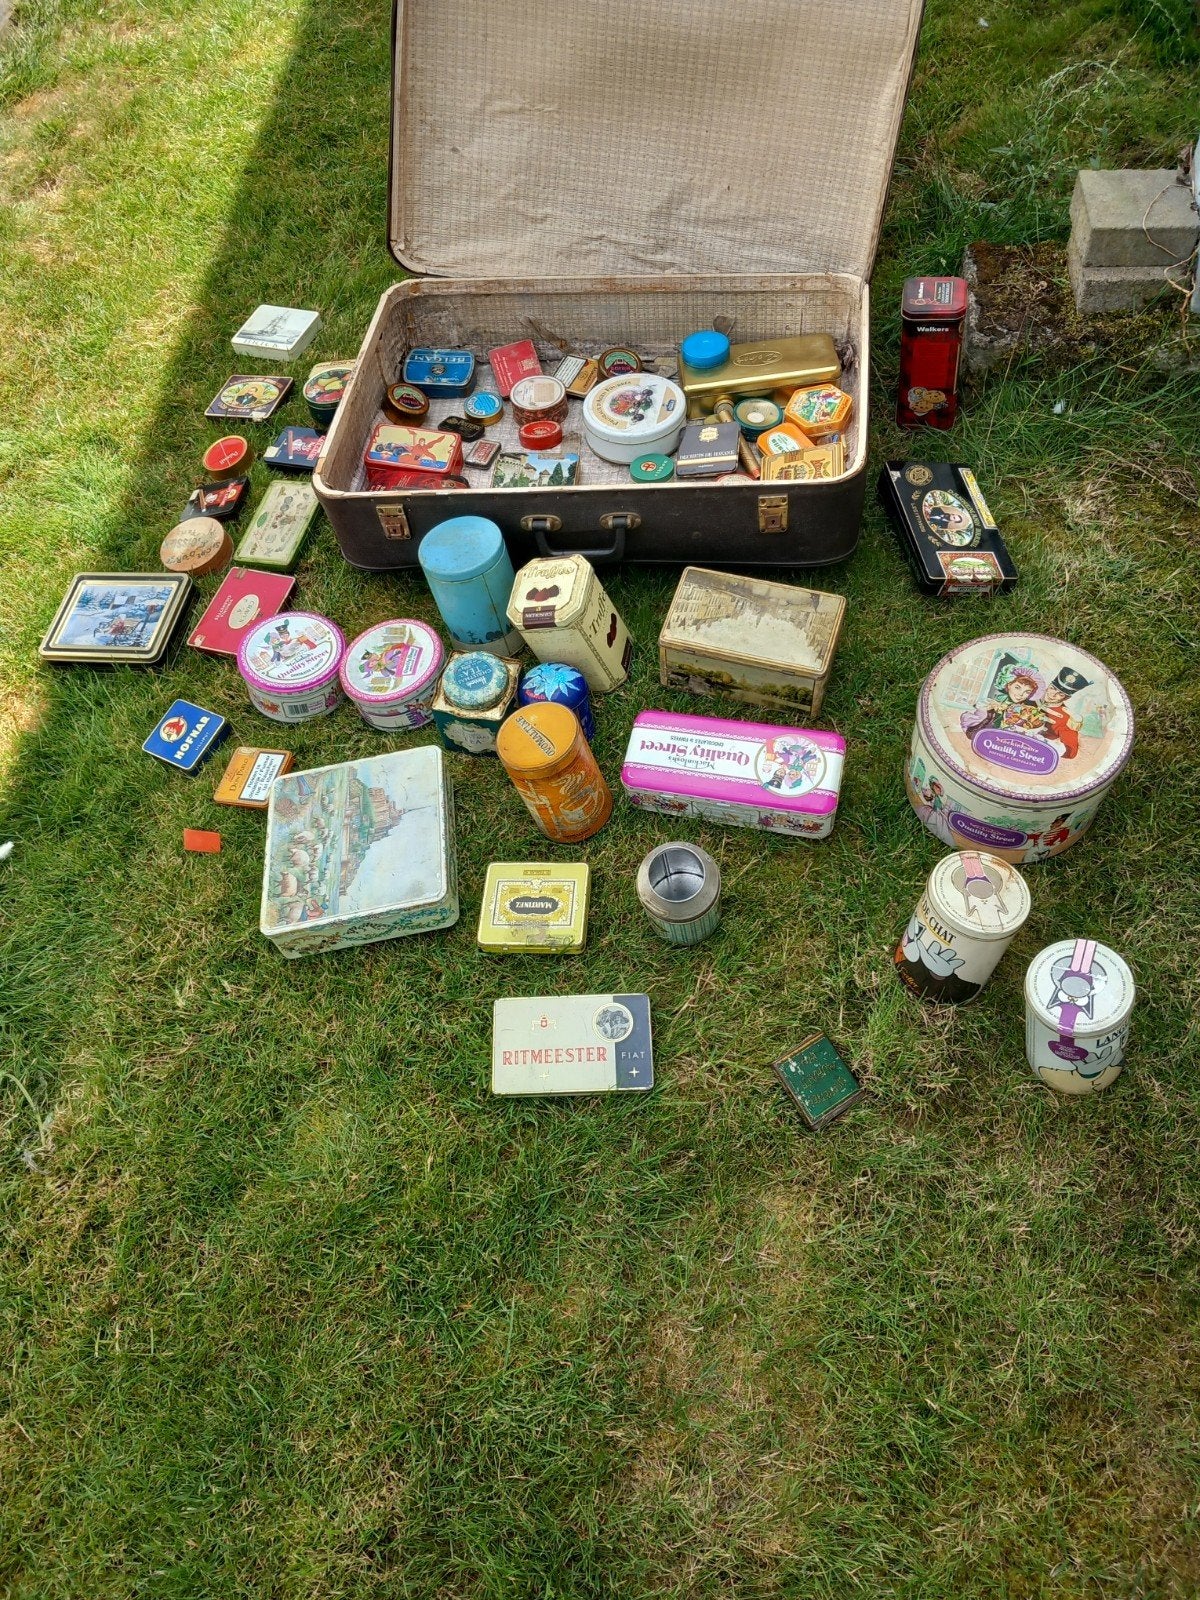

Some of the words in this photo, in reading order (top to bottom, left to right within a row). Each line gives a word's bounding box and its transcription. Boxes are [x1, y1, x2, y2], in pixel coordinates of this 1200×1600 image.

[277, 661, 305, 679] Quality
[305, 650, 329, 663] Street
[173, 715, 210, 759] HOFNAR
[516, 716, 556, 756] OVOMALTINE
[640, 740, 688, 757] Street
[689, 744, 750, 766] Quality
[983, 739, 1017, 757] Quality
[1019, 750, 1045, 764] Street
[668, 756, 715, 770] Mackintosh's
[957, 820, 988, 838] Quality
[990, 833, 1016, 843] Street
[515, 901, 553, 910] MARTINEZ
[929, 916, 956, 943] CHAT
[502, 1046, 608, 1066] RITMEESTER
[622, 1050, 646, 1060] FIAT
